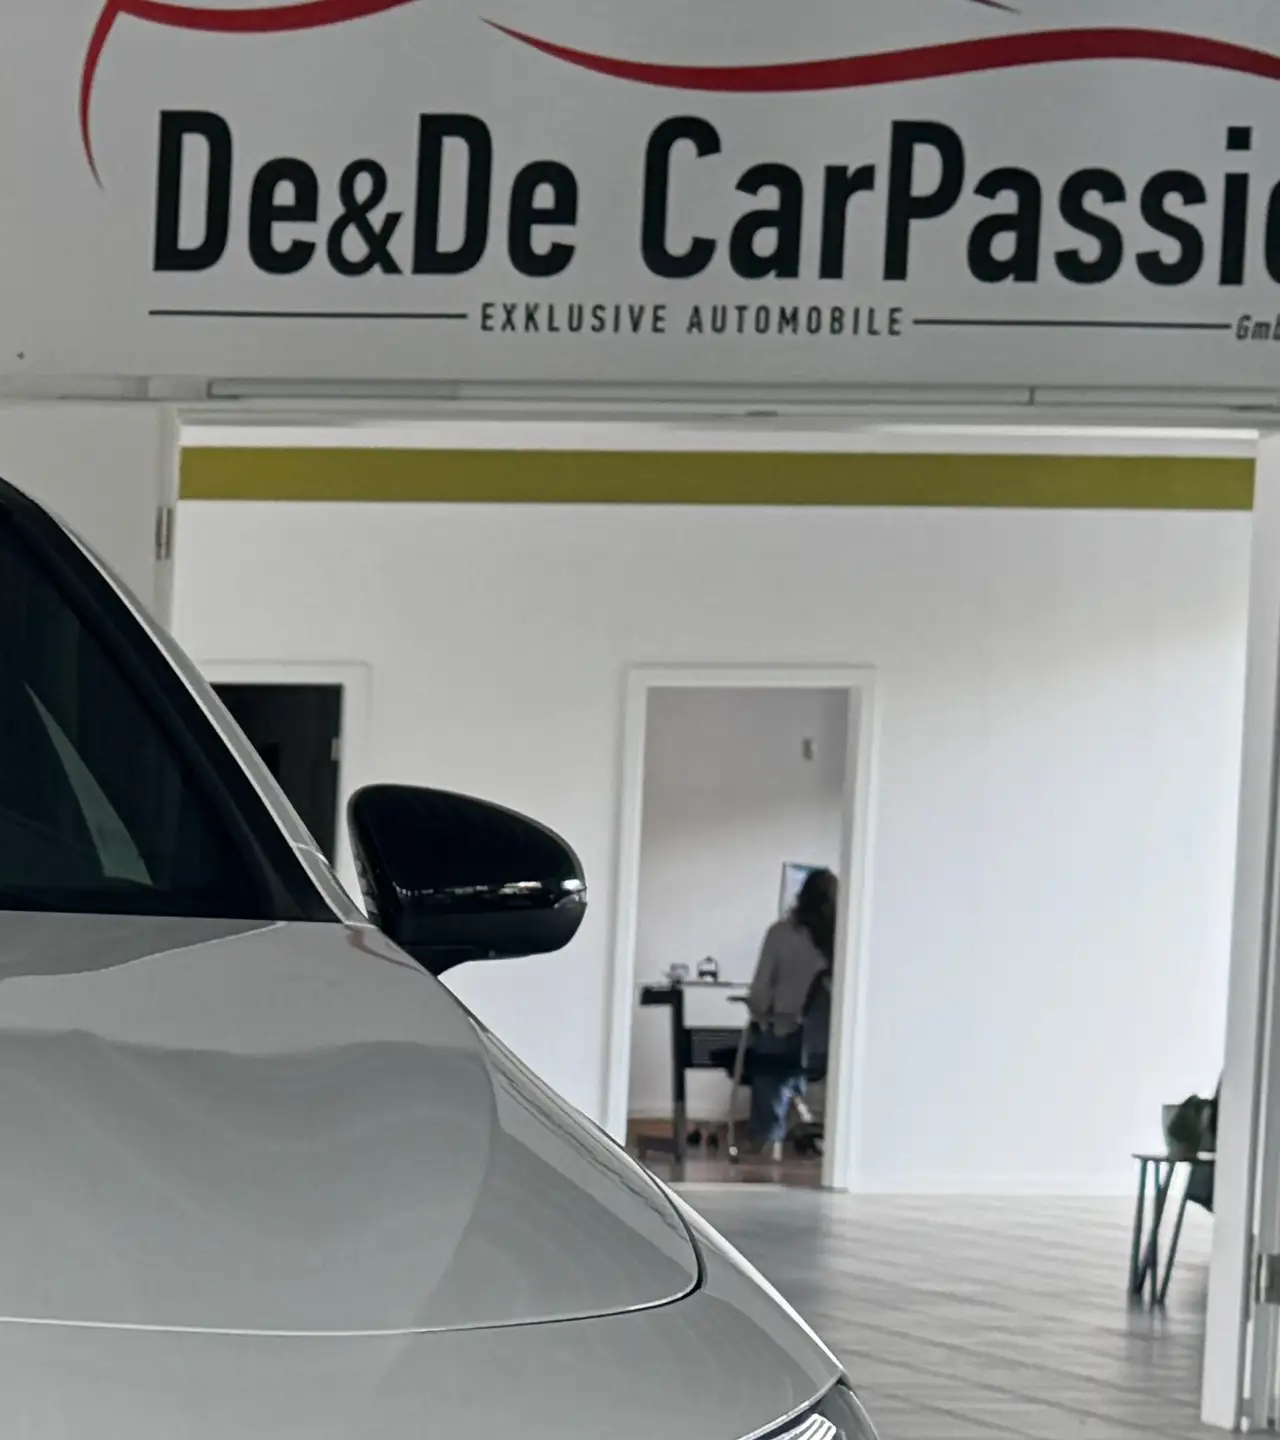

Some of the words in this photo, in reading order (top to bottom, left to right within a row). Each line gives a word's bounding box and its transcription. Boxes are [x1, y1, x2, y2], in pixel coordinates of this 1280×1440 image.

[151, 109, 579, 279] De&De
[639, 114, 1280, 287] CarPassi
[479, 301, 668, 335] EXKLUSIVE
[685, 303, 904, 337] AUTOMOBILE
